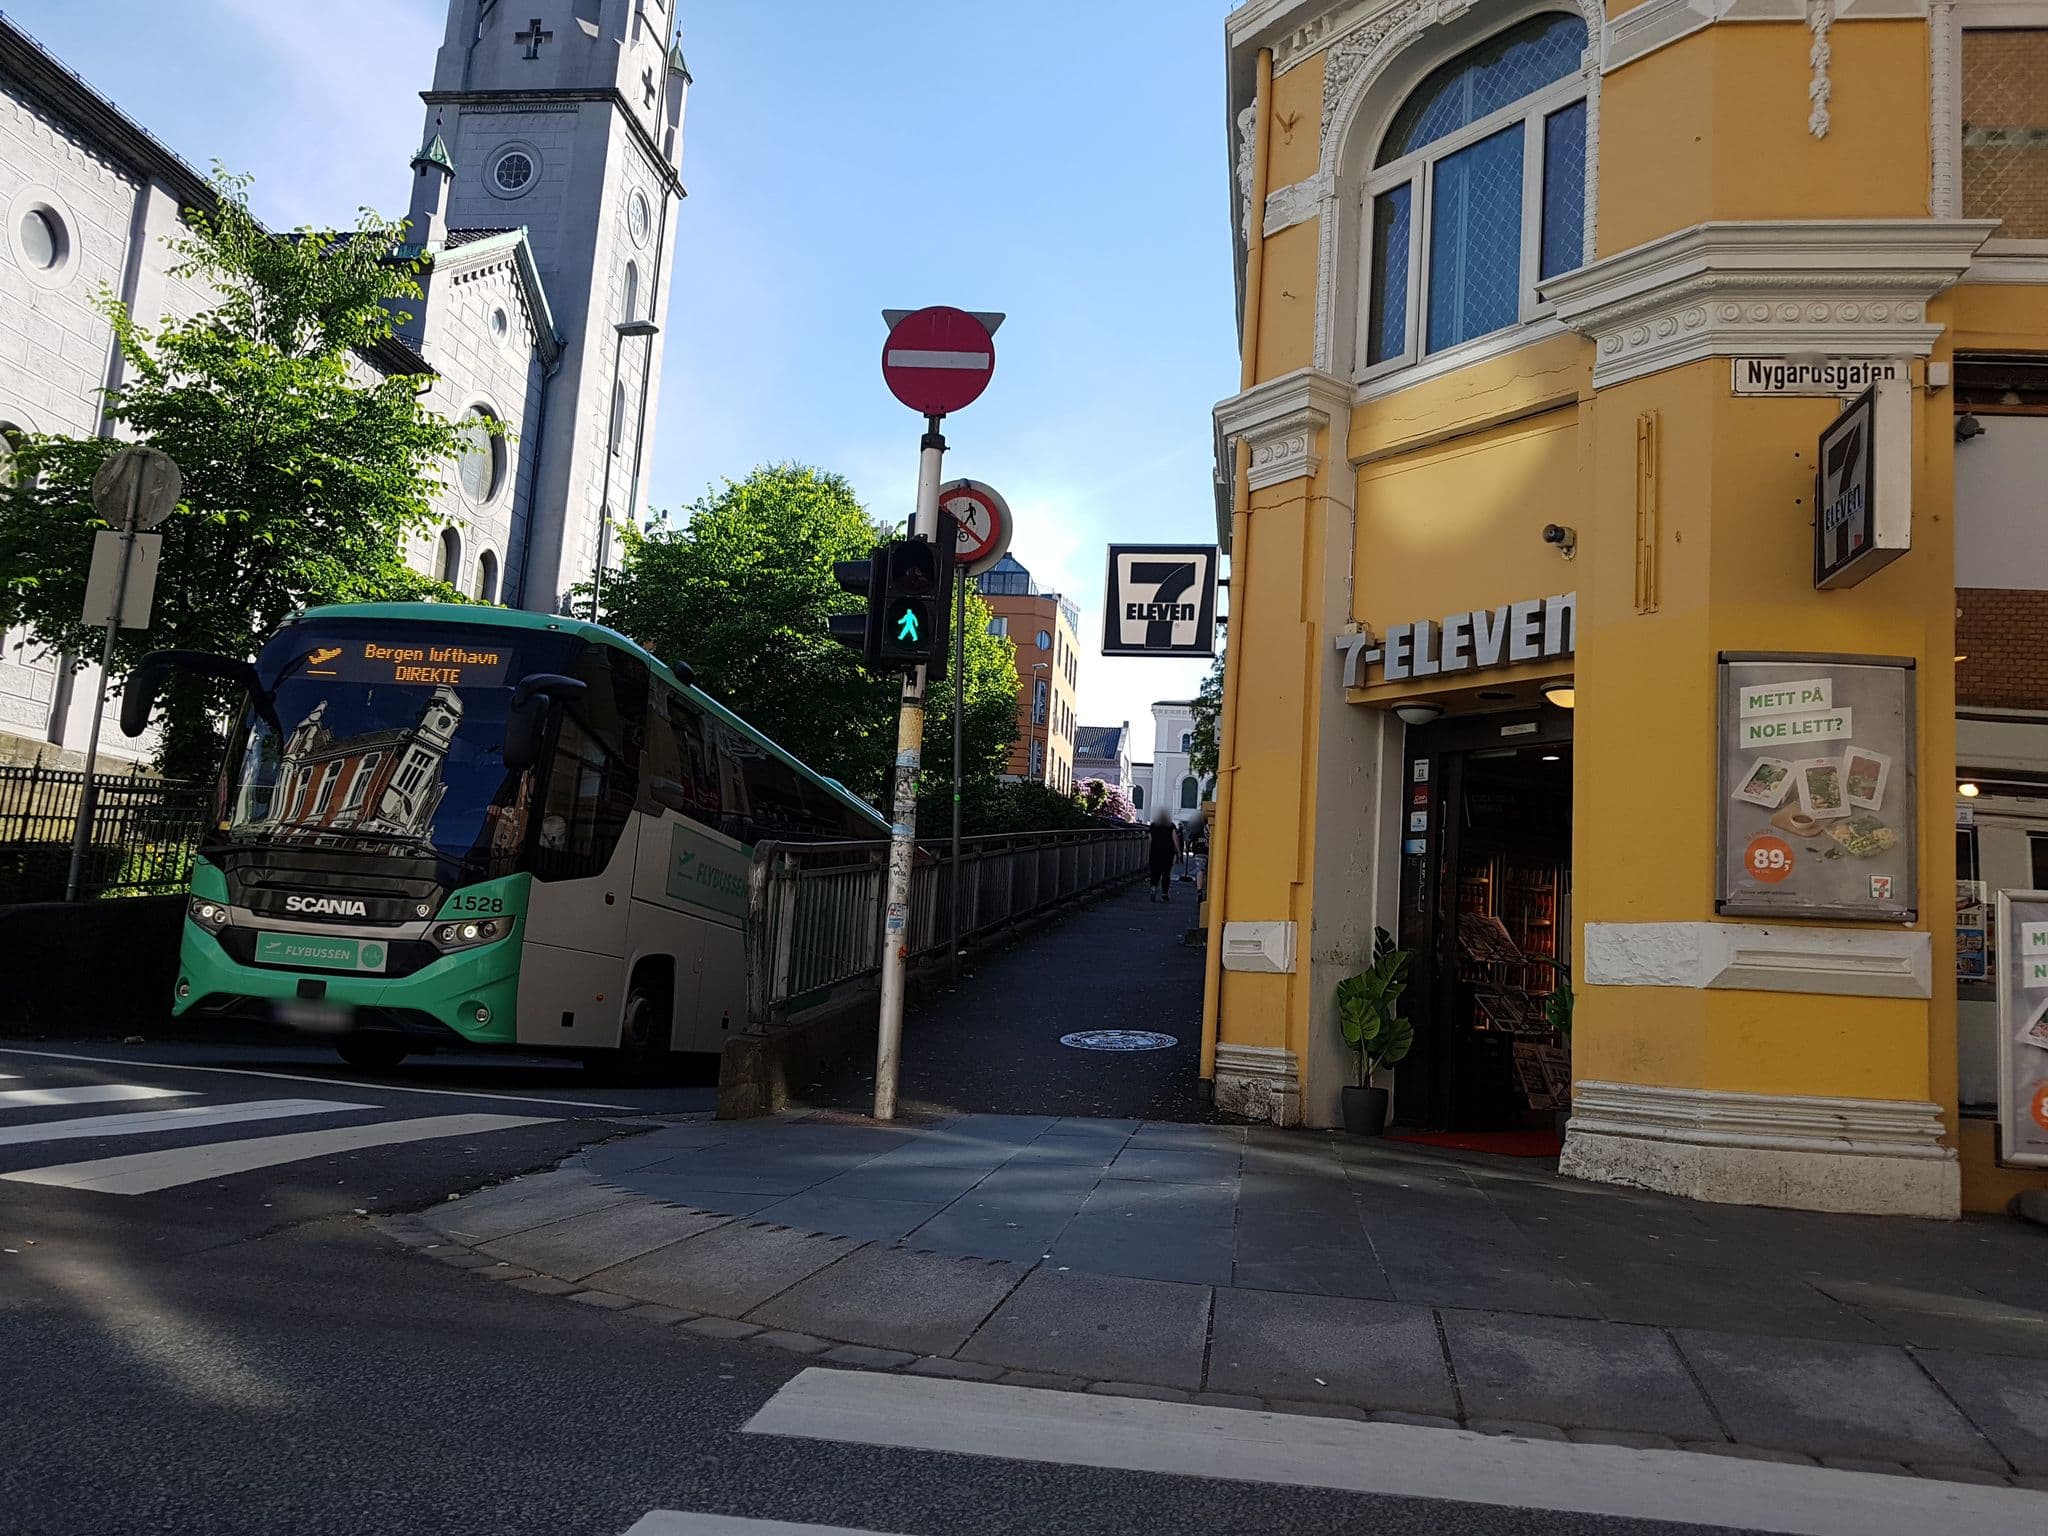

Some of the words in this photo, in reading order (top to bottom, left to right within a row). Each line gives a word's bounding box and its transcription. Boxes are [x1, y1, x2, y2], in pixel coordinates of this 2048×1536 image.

[1827, 421, 1862, 563] 7
[1130, 562, 1195, 648] 7
[364, 643, 423, 663] Bergen
[429, 647, 499, 665] lufthavn
[395, 666, 461, 683] DIREKTE
[1749, 691, 1796, 709] METT
[1801, 686, 1824, 704] PÅ
[1749, 722, 1787, 739] NOE
[1792, 717, 1843, 735] LETT?
[285, 896, 367, 916] SCANIA
[452, 895, 503, 912] 1528
[285, 945, 351, 960] FLYBUSSEN
